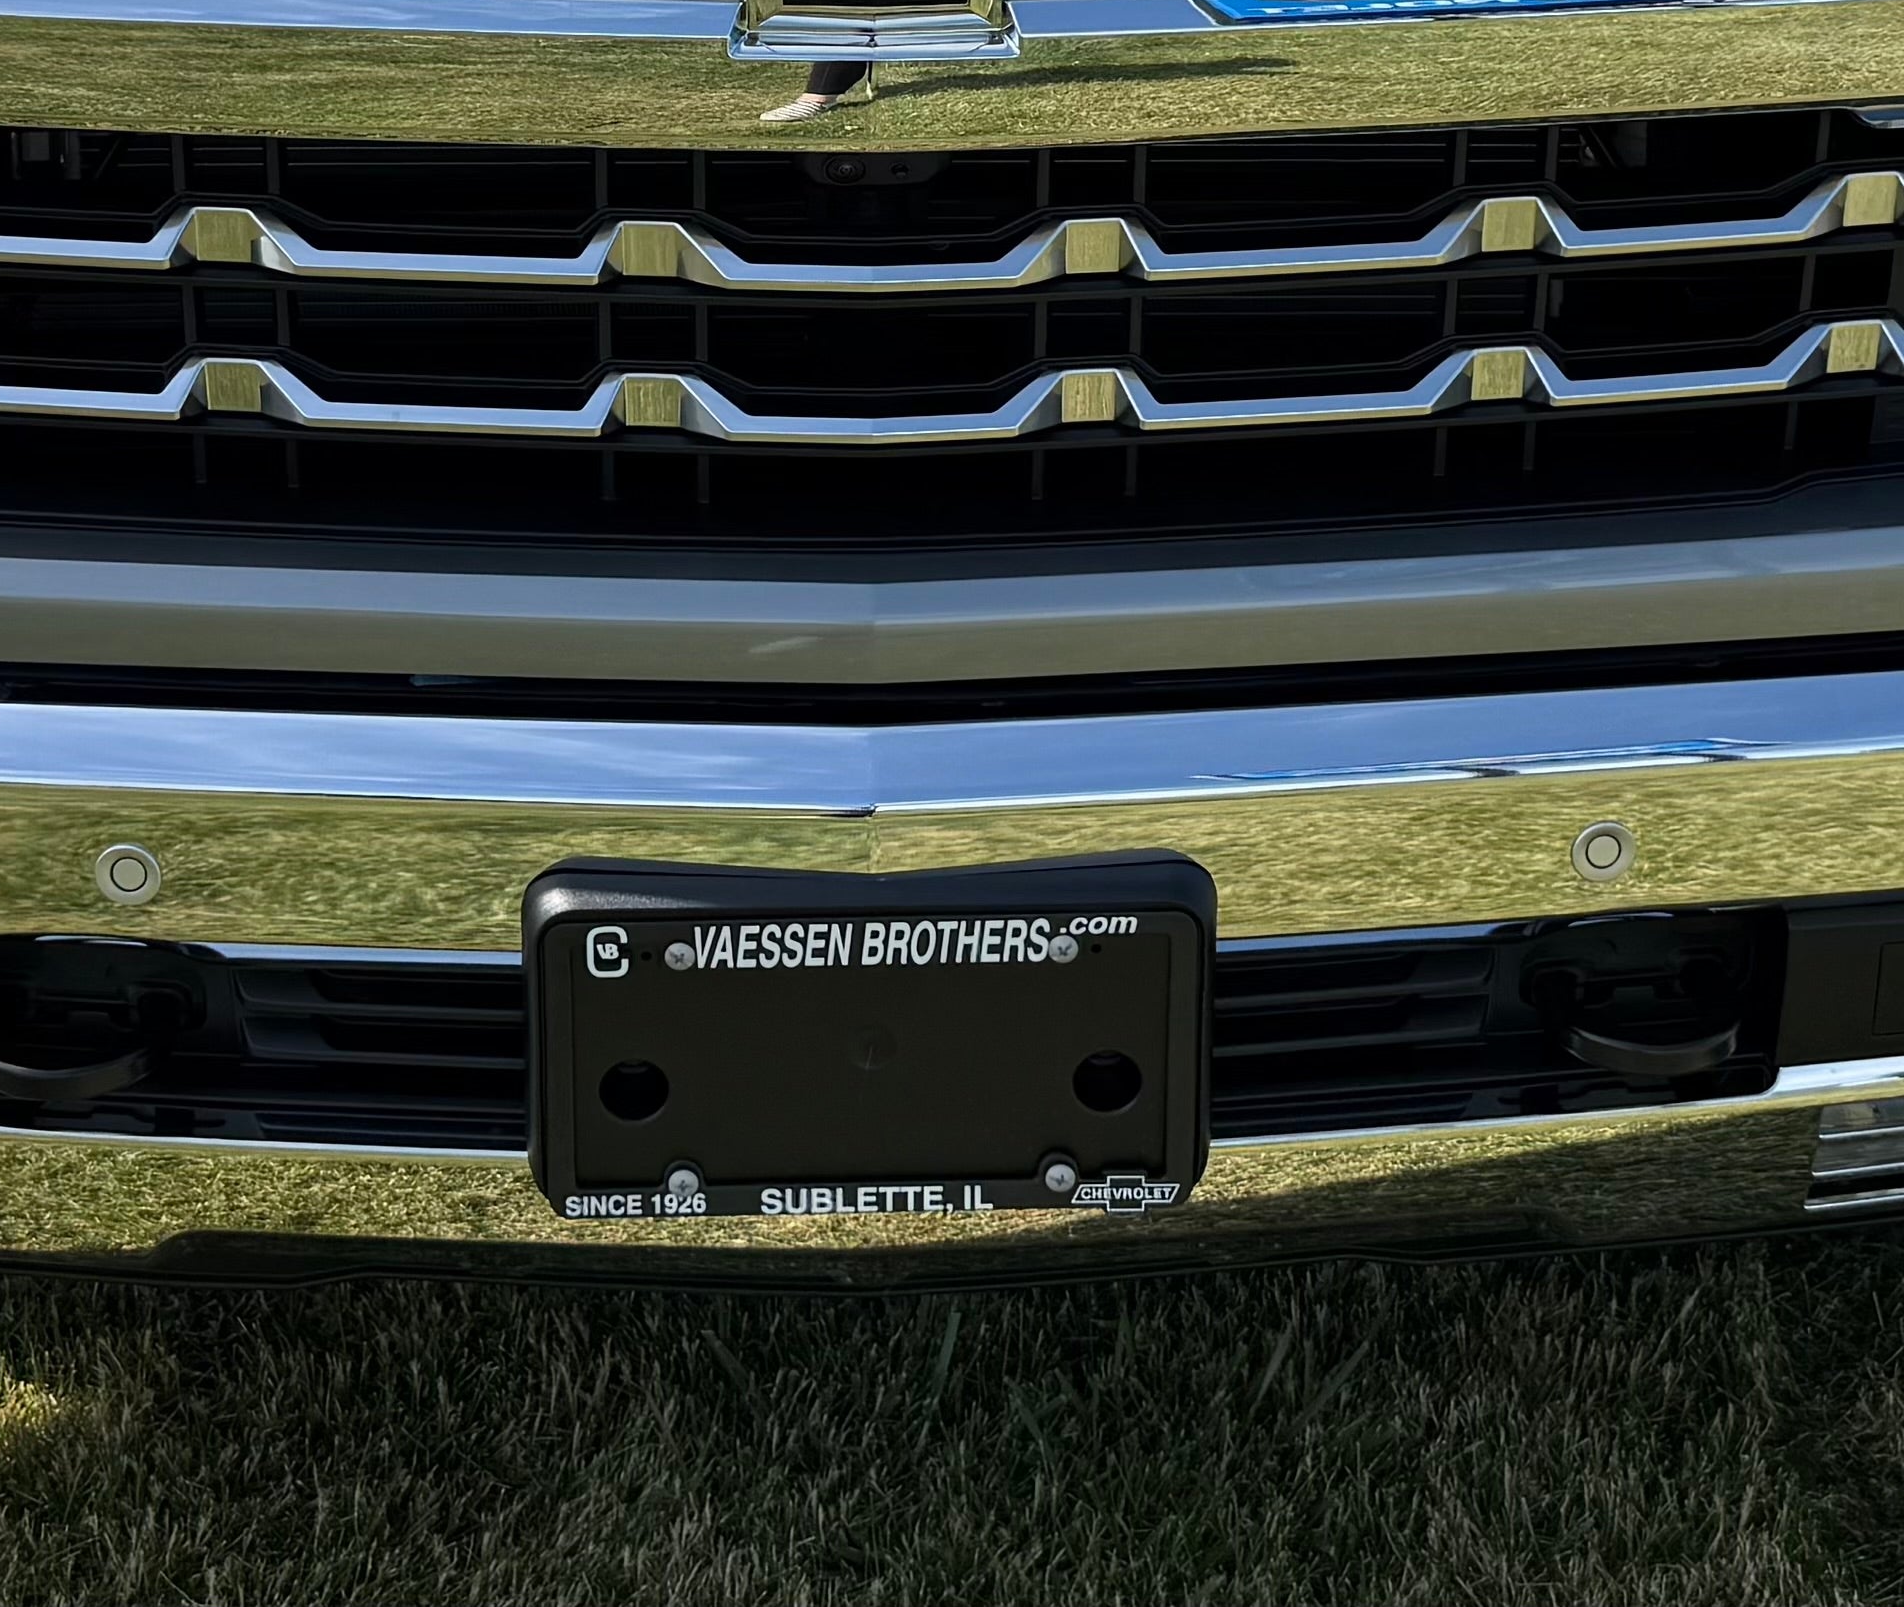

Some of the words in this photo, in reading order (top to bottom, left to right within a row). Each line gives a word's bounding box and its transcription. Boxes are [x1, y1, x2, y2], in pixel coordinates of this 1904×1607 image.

[694, 922, 854, 970] VAESSEN
[860, 917, 1051, 967] BROTHERS
[564, 1194, 643, 1217] SINCE
[650, 1192, 707, 1215] 1926
[760, 1185, 954, 1214] SUBLETTE,
[963, 1184, 994, 1211] IL
[1080, 1186, 1173, 1200] CHEVROLET
